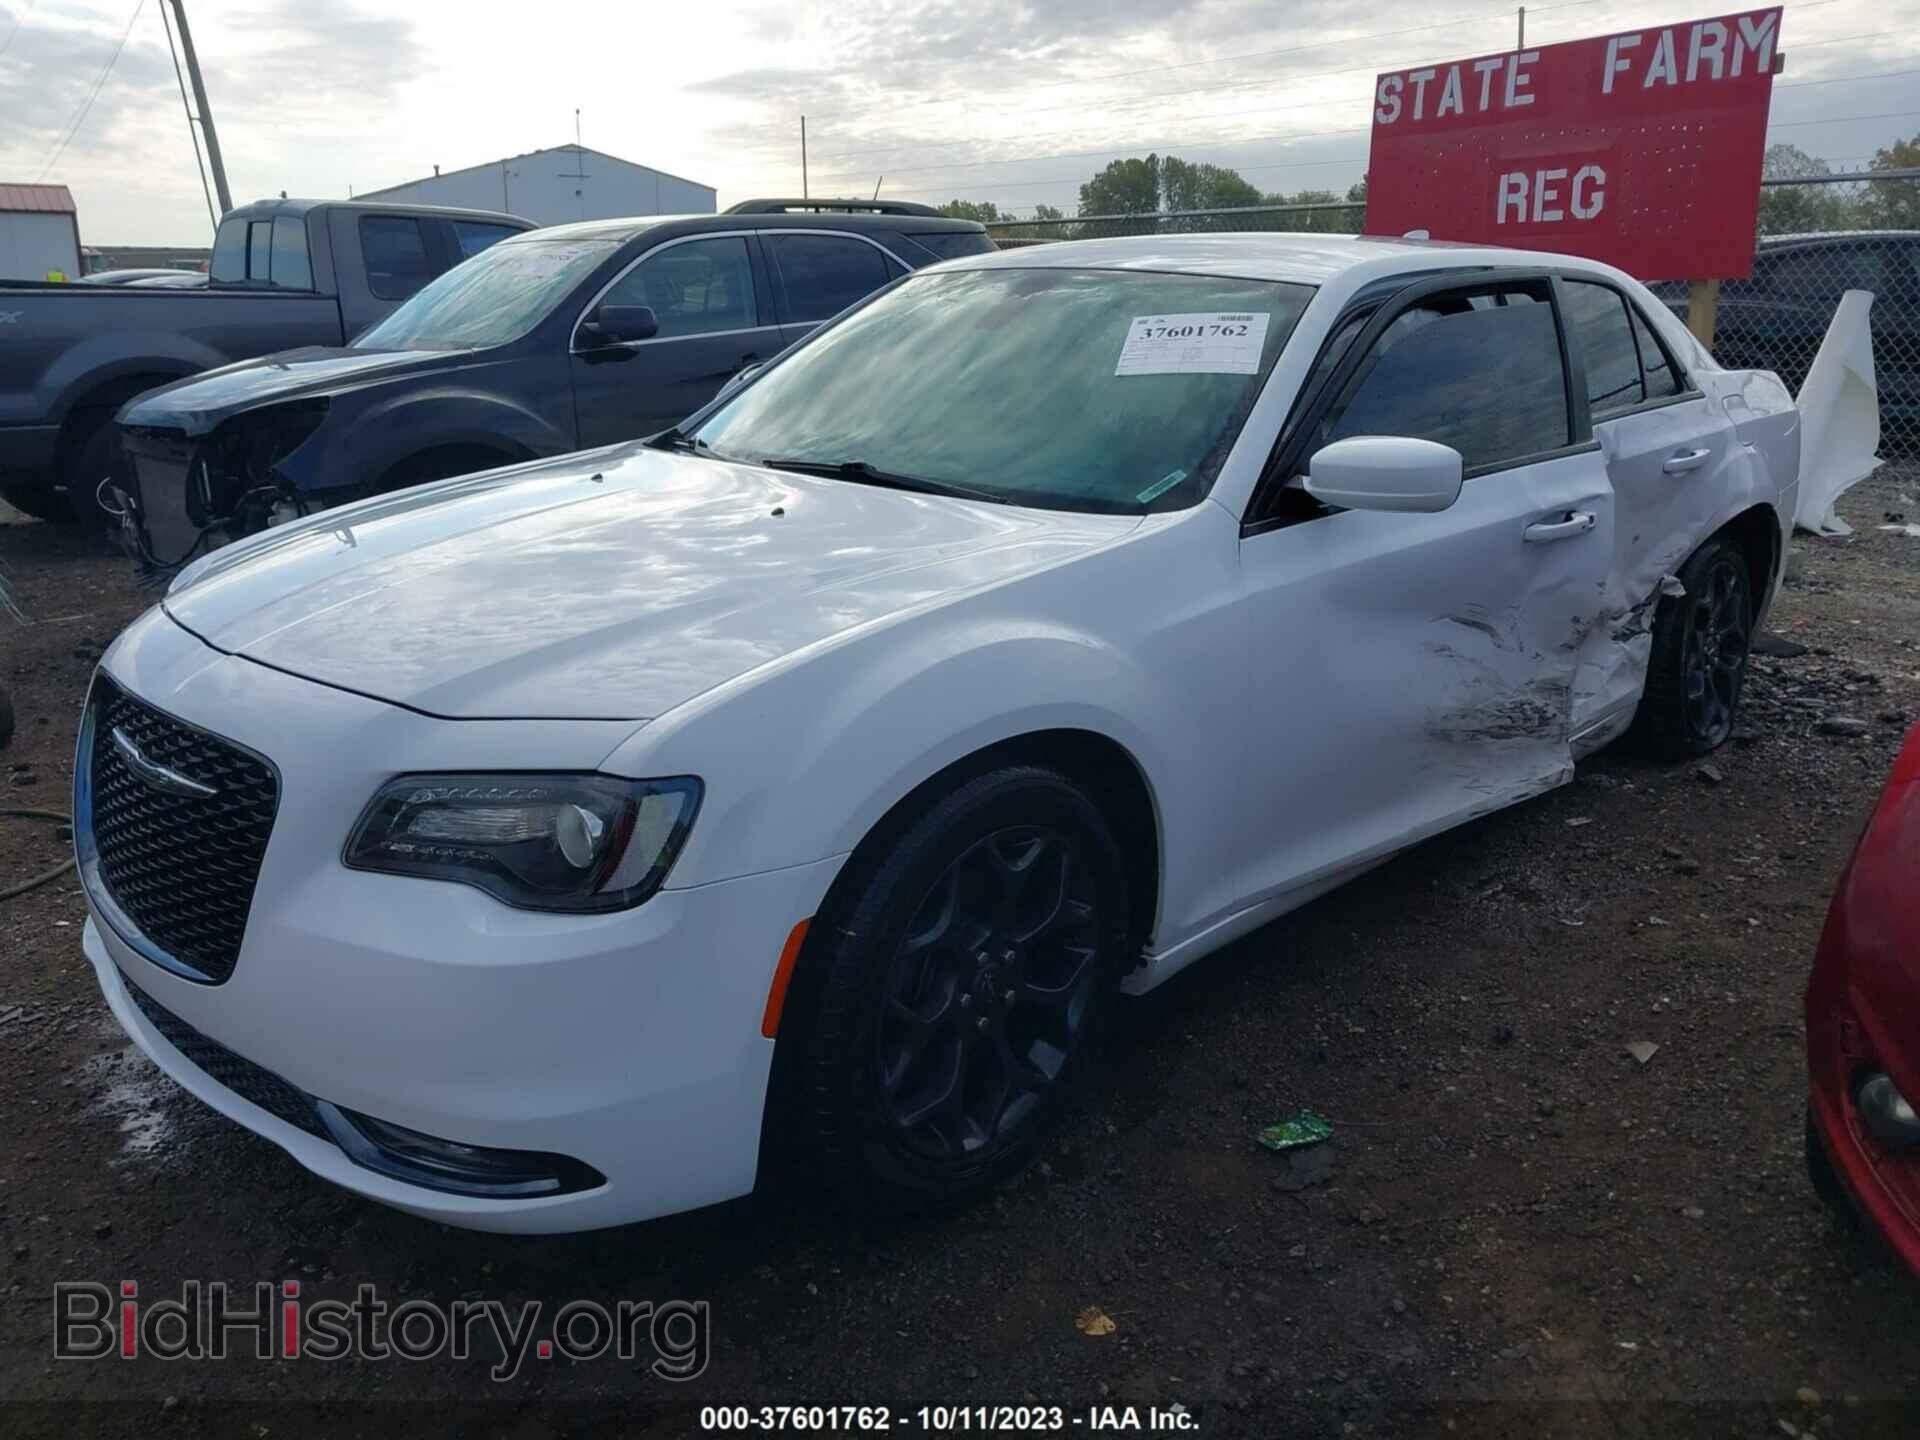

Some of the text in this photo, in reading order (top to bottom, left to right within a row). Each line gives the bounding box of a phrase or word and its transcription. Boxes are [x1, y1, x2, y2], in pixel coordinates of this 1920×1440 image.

[1375, 13, 1777, 125] STATE FARM
[1497, 166, 1606, 225] REG
[1140, 325, 1248, 339] 37601762
